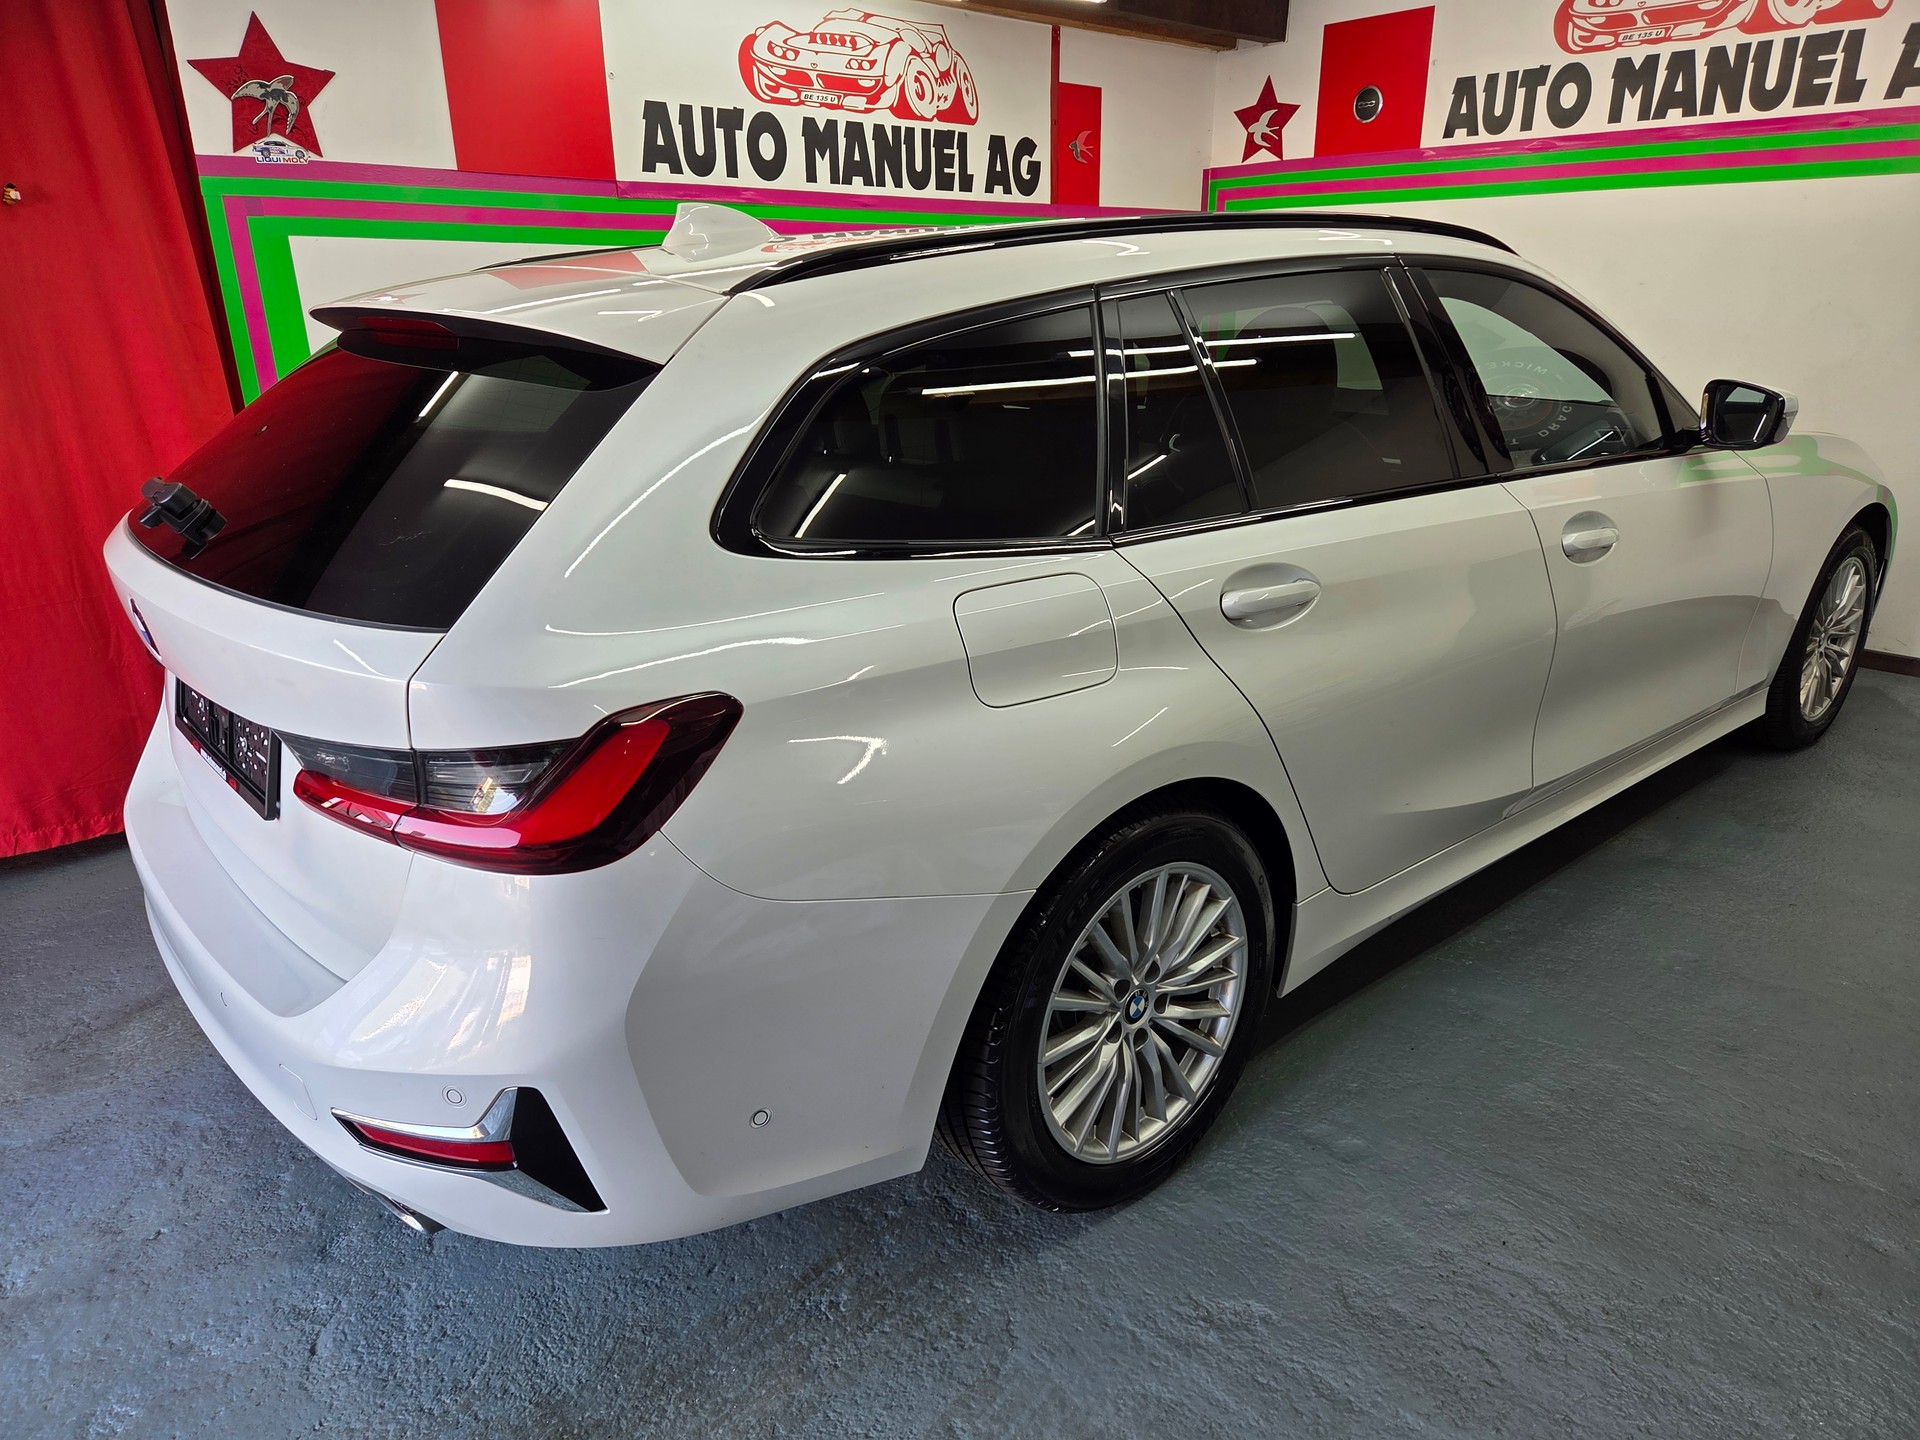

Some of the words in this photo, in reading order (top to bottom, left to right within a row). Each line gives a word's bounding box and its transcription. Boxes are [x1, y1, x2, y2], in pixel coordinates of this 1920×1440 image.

[1442, 61, 1593, 139] AUTO
[1607, 27, 1868, 124] MANUEL
[1621, 33, 1636, 41] BE
[1637, 31, 1653, 39] 135
[642, 99, 788, 182] AUTO
[801, 116, 974, 193] MANUEL
[984, 134, 1042, 197] AG
